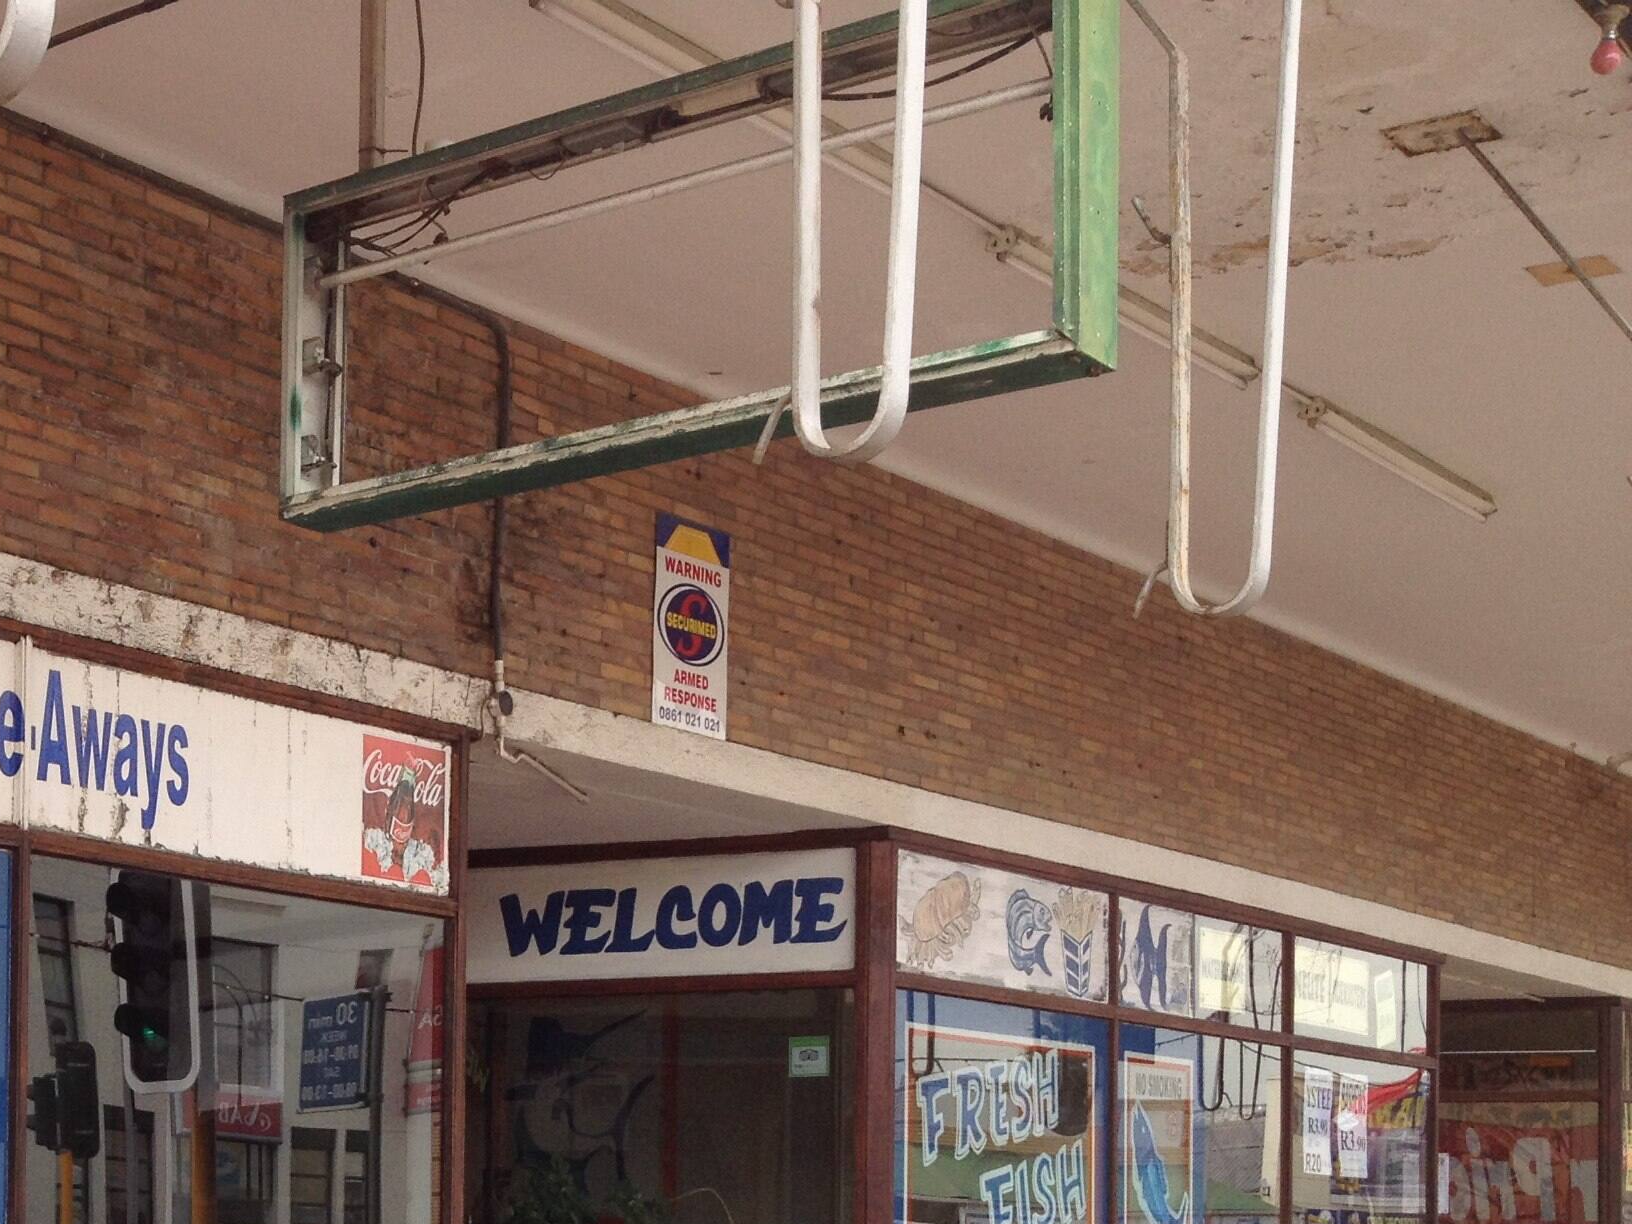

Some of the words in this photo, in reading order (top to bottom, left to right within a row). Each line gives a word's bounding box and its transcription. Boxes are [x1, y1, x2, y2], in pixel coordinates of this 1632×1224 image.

[665, 555, 721, 588] WARNING
[666, 611, 717, 639] SECURIMED
[674, 668, 709, 690] ARMED
[664, 686, 717, 713] RESPONSE
[659, 706, 682, 724] 0861
[685, 712, 701, 728] 021
[704, 716, 720, 733] 021
[499, 877, 849, 958] WELCOME
[1136, 1072, 1146, 1095] NO
[1148, 1074, 1182, 1099] SMOKING
[916, 1048, 1060, 1167] FRESH
